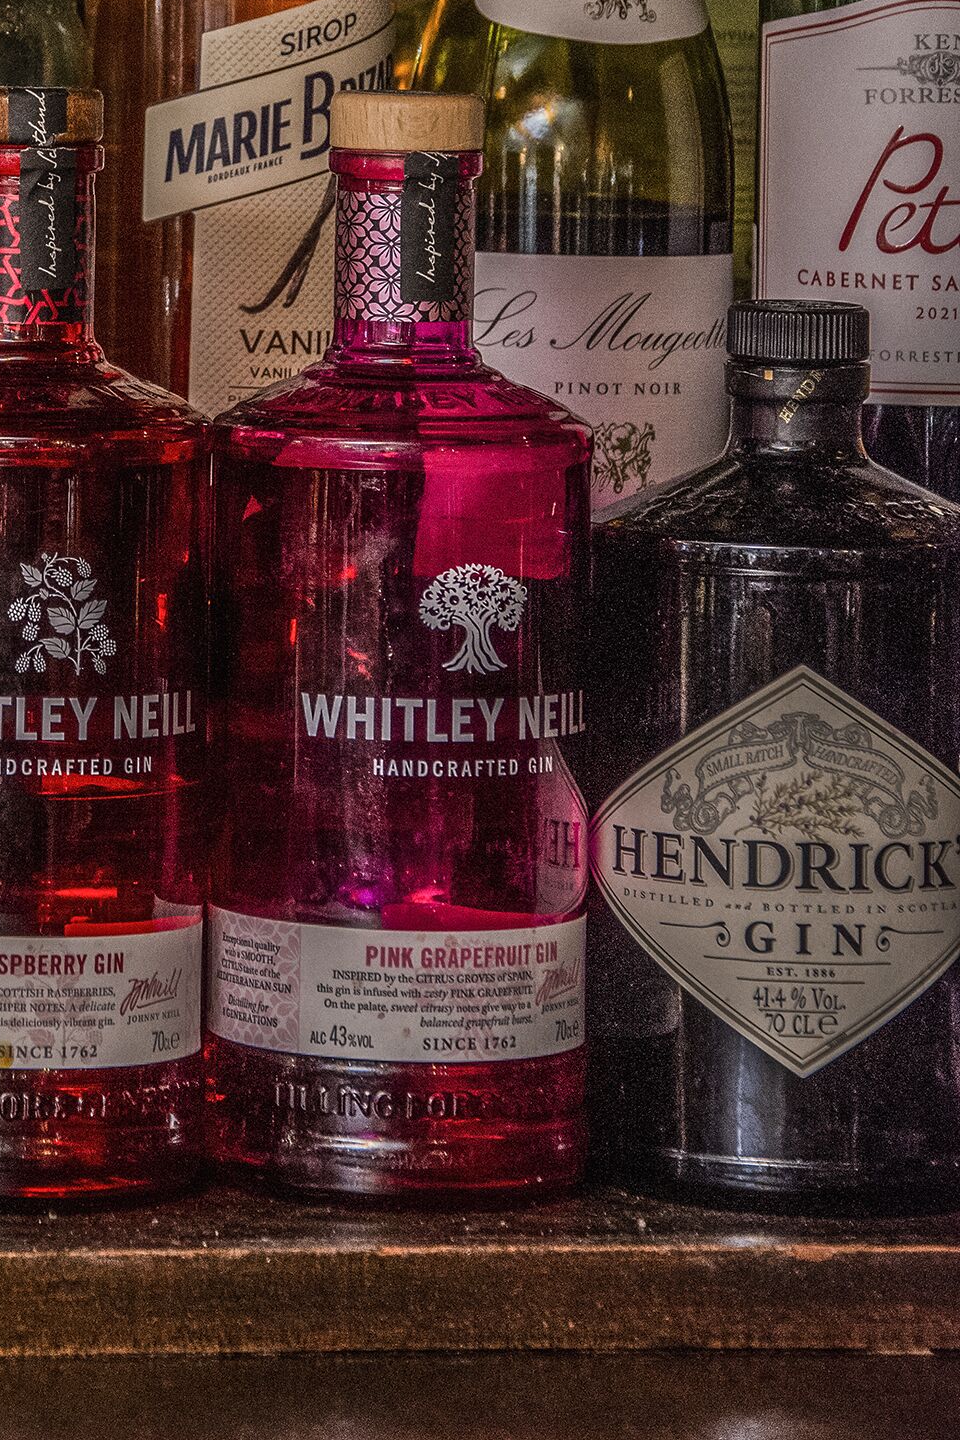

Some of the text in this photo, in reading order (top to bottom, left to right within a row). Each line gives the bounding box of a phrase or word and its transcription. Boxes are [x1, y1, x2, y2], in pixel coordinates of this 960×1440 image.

[280, 12, 358, 57] SIROP
[164, 98, 292, 184] MARIE
[37, 171, 61, 191] by
[207, 156, 284, 185] BORDEAUX FRANCE
[418, 172, 444, 191] by
[38, 199, 62, 278] Inspired
[416, 197, 442, 283] Inspired
[797, 268, 920, 291] CABERNET
[474, 287, 538, 349] Les
[916, 306, 958, 320] 2021
[554, 381, 682, 396] PINOT NOIR
[113, 690, 196, 740] NEILL
[301, 690, 586, 743] WHITLEY NEILL
[124, 756, 153, 775] GIN
[373, 755, 554, 778] HANDCRAFTED GIN
[706, 744, 785, 777] SMALL BATCH
[813, 743, 900, 786] HANDCRAFTED
[623, 887, 887, 914] DISTILLED BOTTLED IN
[222, 932, 281, 955] Exceptional quality
[744, 920, 867, 957] GIN
[94, 952, 125, 975] GIN
[365, 941, 558, 969] PINK GRAPEFRUIT GIN
[332, 969, 496, 985] INSPIRED by the CITRUS GROVES
[766, 966, 837, 978] EST. 1886
[272, 982, 292, 994] SUN
[316, 983, 476, 1002] this gin infused with zesty PINK
[753, 986, 787, 1008] 41.4
[78, 1001, 116, 1011] delicate
[323, 998, 338, 1009] On
[340, 1000, 356, 1010] the
[390, 1004, 418, 1013] sweet
[420, 1003, 455, 1016] citrusy
[456, 1003, 480, 1013] notes
[482, 1002, 500, 1015] give
[10, 1017, 62, 1030] deliciously
[63, 1018, 96, 1028] vibrant
[127, 1012, 160, 1025] JOHNNY
[227, 1009, 278, 1028] GENERATIONS
[419, 1015, 510, 1030] balanced grapefruit
[310, 1030, 327, 1045] ALC
[422, 1035, 517, 1051] SINCE 1762
[61, 1045, 98, 1059] 1762
